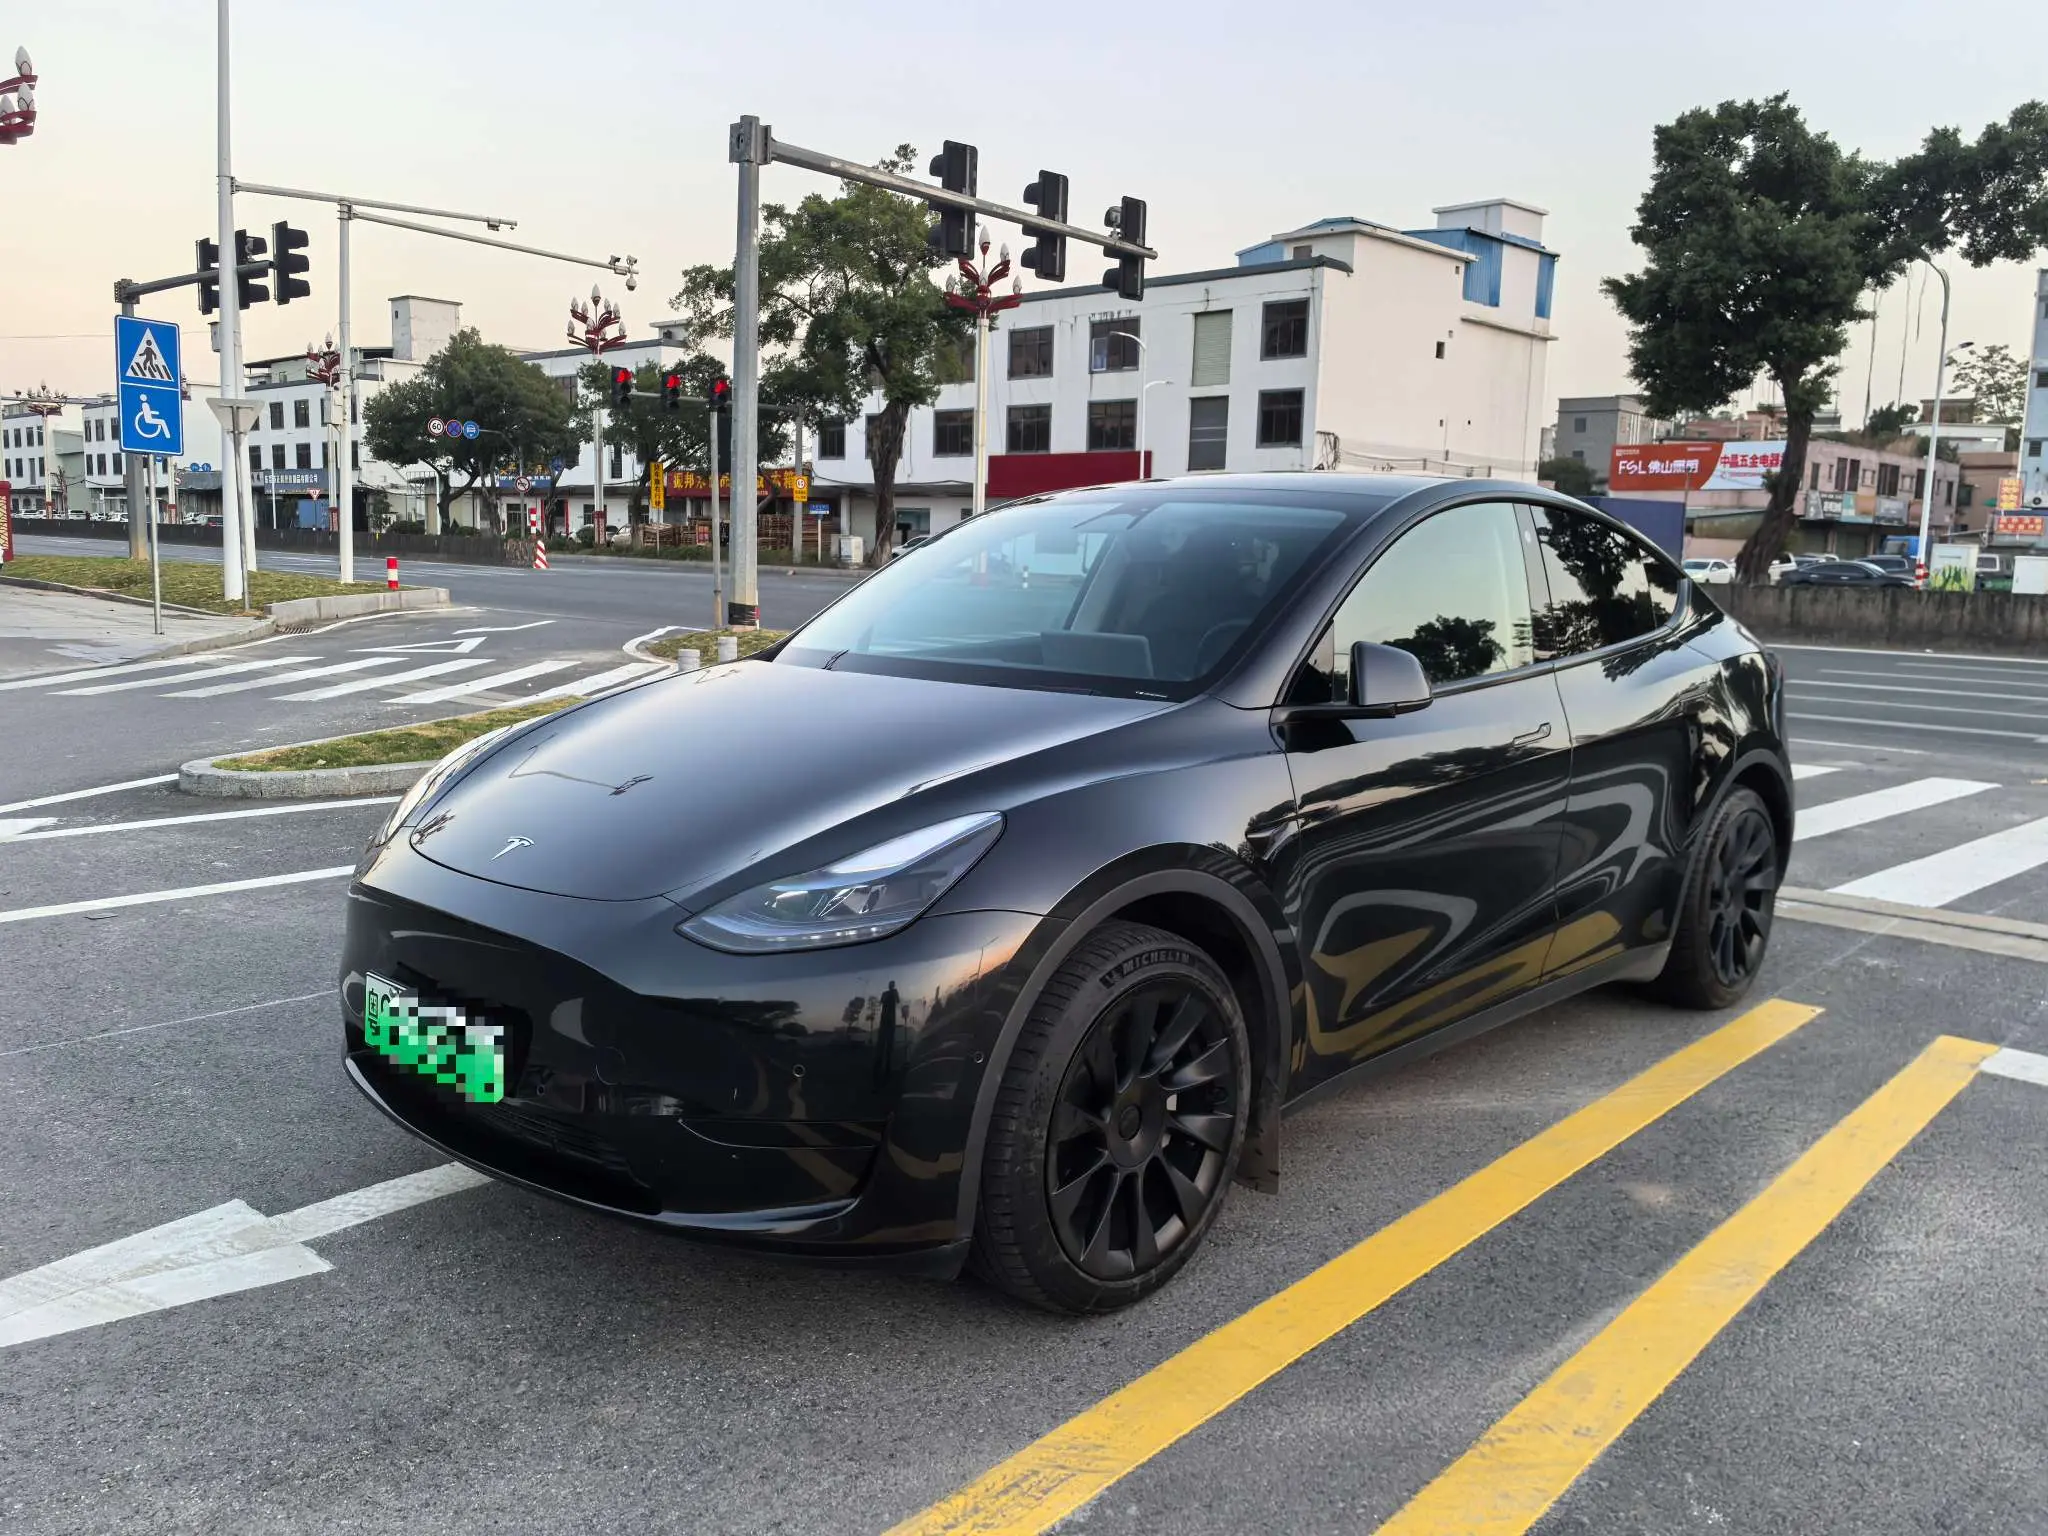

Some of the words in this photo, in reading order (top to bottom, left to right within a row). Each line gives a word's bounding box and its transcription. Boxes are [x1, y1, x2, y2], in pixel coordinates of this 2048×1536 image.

[432, 422, 442, 431] 60
[1618, 460, 1647, 475] FSL
[1122, 950, 1190, 975] MICHELIN
